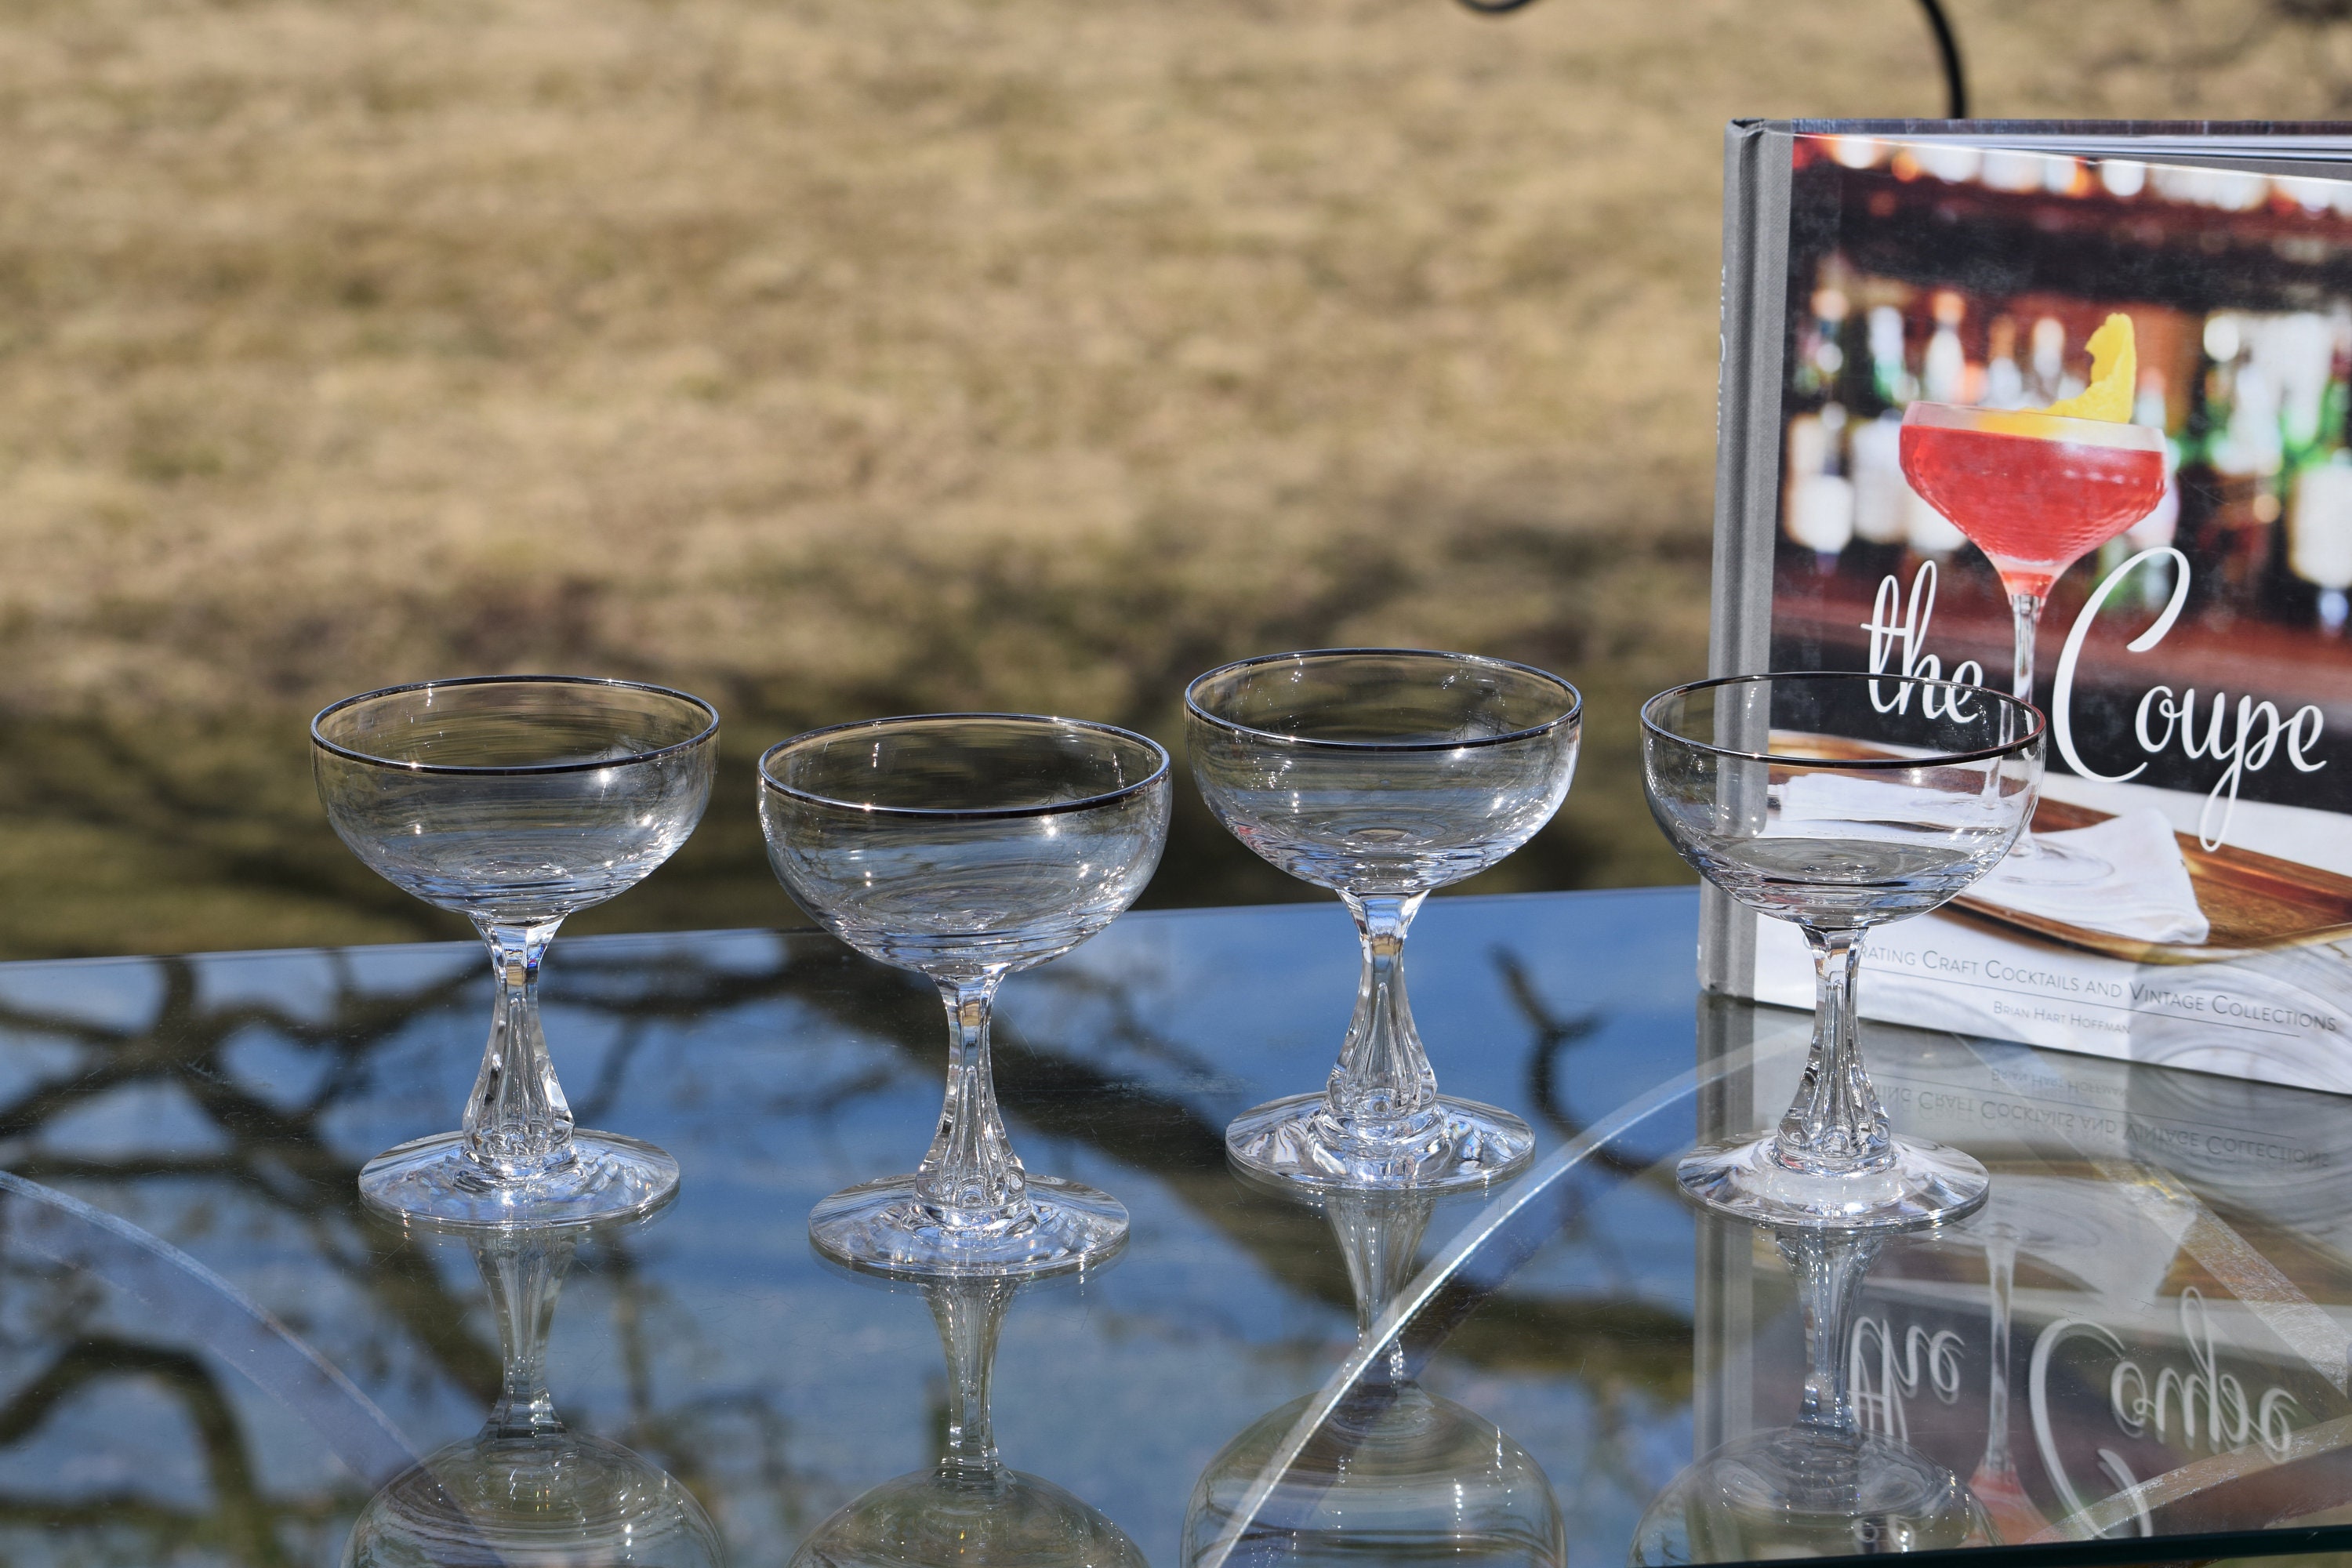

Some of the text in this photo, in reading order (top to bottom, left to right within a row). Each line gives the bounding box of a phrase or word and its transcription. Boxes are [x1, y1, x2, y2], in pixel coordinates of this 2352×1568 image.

[1860, 546, 2327, 852] the Coupe
[1922, 949, 1979, 975] CRAFT
[1985, 960, 2080, 993] COCKTAILS
[2085, 980, 2122, 998] AND
[2129, 982, 2205, 1011] VINTAGE
[2212, 995, 2337, 1033] COLLECTIONS
[1993, 1000, 2131, 1035] BRIAN HART HOFFMAN
